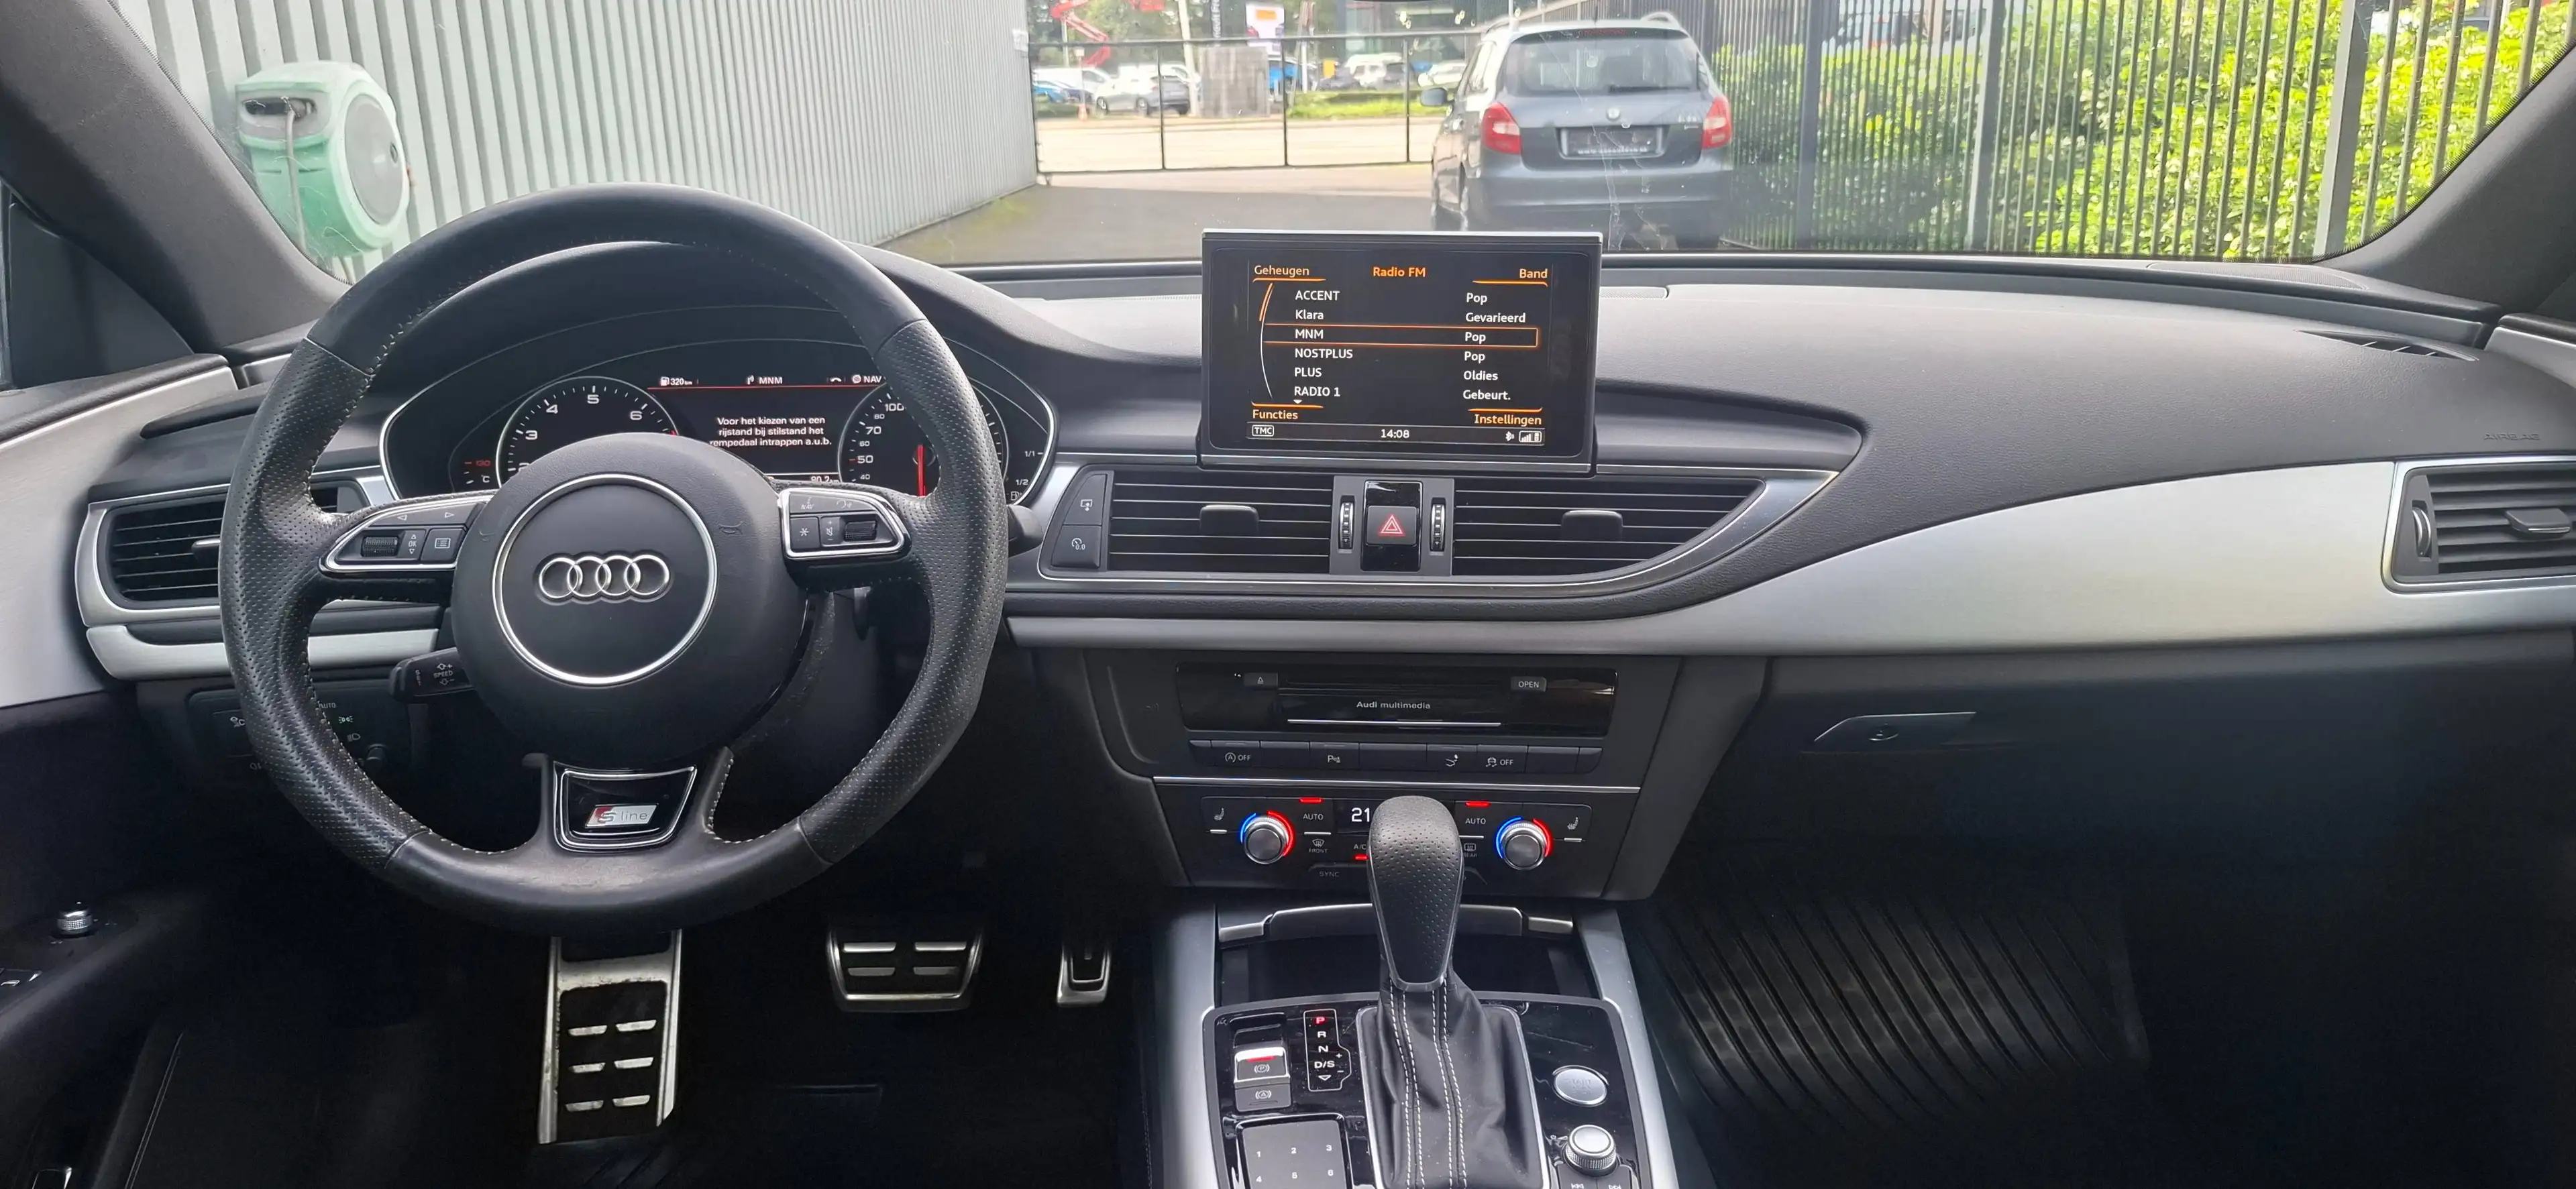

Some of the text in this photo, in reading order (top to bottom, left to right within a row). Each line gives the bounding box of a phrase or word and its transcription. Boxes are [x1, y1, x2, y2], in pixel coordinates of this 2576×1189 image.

[1254, 264, 1309, 278] Geheugen
[1373, 266, 1426, 278] Radio FM
[1519, 268, 1548, 279] Band
[1295, 290, 1340, 301] ACCENT
[1466, 292, 1488, 306] Pop
[1295, 308, 1324, 320] Klara
[1465, 312, 1526, 323] Gevarieerd
[1295, 329, 1324, 339] MNM
[1464, 332, 1487, 345] Pop
[1295, 347, 1353, 359] NOSTPLUS
[1464, 351, 1486, 364] Pop
[1294, 367, 1322, 378] PLUS
[1463, 370, 1499, 381] Oldies
[759, 376, 783, 384] MNM
[863, 376, 882, 384] NAV
[1294, 386, 1340, 397] RADIO 1
[1462, 389, 1511, 400] Gebeurt.
[587, 394, 600, 404] 5
[545, 404, 559, 414] 4
[884, 402, 904, 411] 100
[630, 410, 643, 420] 6
[1252, 409, 1298, 420] Functies
[716, 417, 739, 425] Voor
[741, 416, 757, 425] het
[758, 416, 788, 425] kiezen
[1474, 414, 1542, 427] Instellingen
[525, 430, 538, 440] 3
[718, 427, 824, 437] rijstand bij stilstand het
[865, 426, 881, 435] 70
[1254, 425, 1273, 437] TMC
[1381, 429, 1410, 439] 14:08
[709, 437, 832, 447] rempedaal intrappen a.u.b.
[857, 455, 873, 464] 50
[1380, 701, 1431, 710] multimedia
[621, 811, 648, 821] line
[1314, 1060, 1335, 1068] D/S
